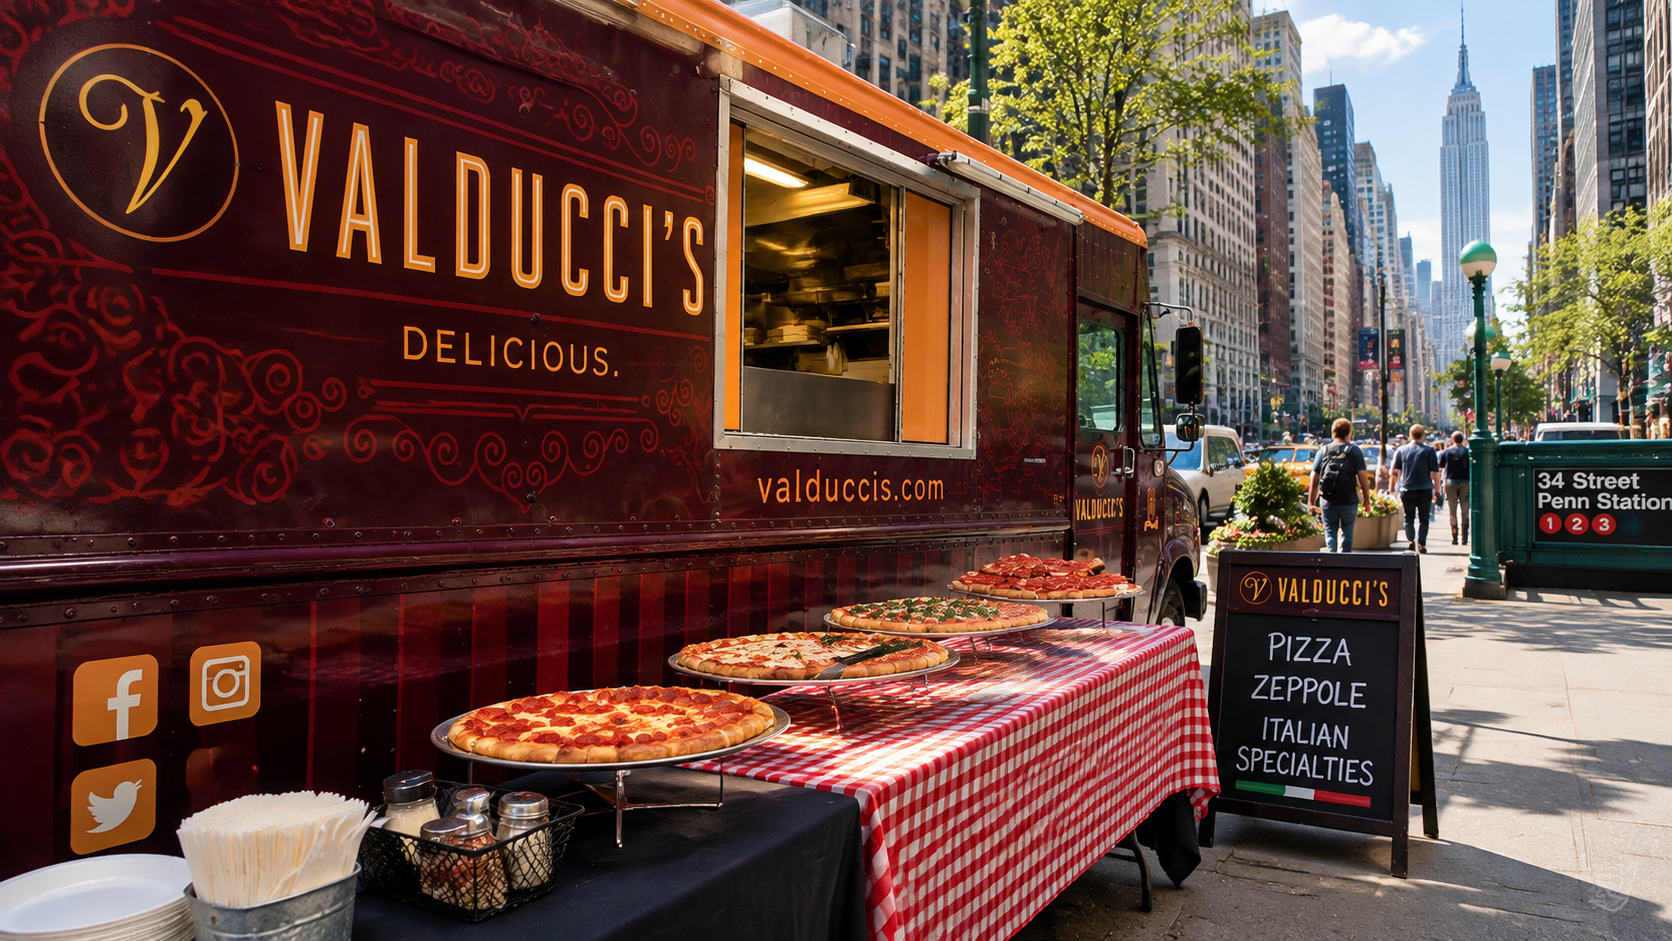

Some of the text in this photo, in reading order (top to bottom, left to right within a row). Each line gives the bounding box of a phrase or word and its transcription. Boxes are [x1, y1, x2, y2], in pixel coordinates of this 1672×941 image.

[79, 74, 207, 214] V
[275, 100, 704, 316] VALDUCCI'S
[403, 325, 619, 377] DELICIOUS.
[757, 469, 944, 504] valduccis.com
[1537, 472, 1640, 489] 34 Street
[1538, 492, 1672, 510] Penn Station
[1546, 517, 1610, 531] 1 2 3
[1244, 577, 1389, 607] V VALDUCCI'S
[1268, 632, 1352, 666] PIZZA
[1251, 675, 1367, 709] ZEPPOLE
[1262, 716, 1349, 750] ITALIAN
[1236, 745, 1374, 787] SPECIALTIES
